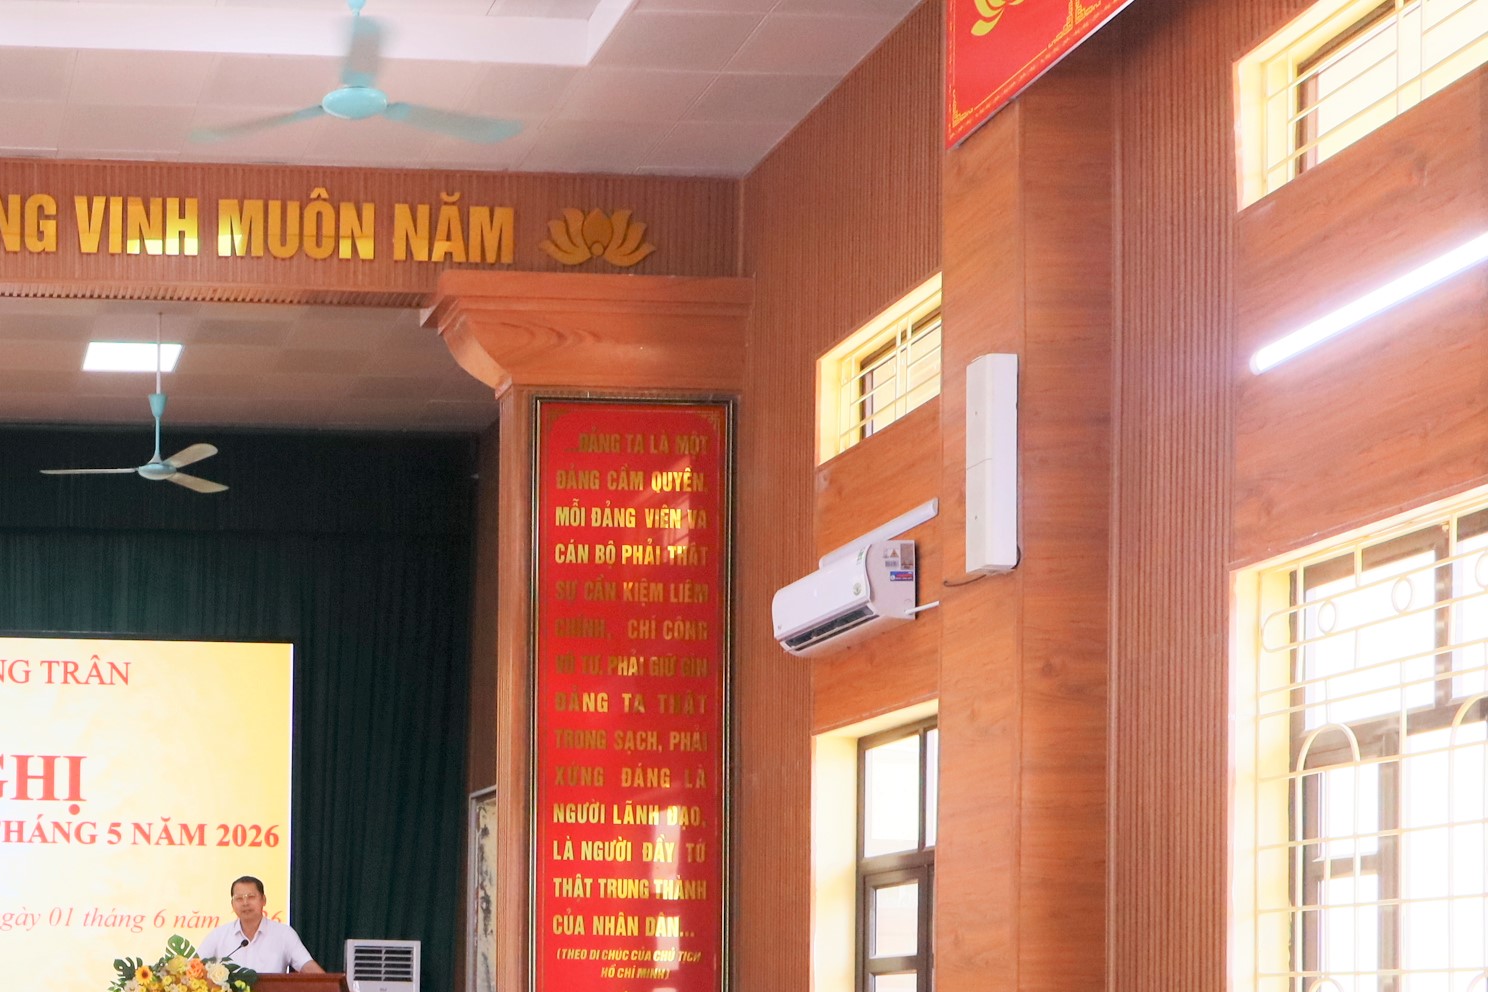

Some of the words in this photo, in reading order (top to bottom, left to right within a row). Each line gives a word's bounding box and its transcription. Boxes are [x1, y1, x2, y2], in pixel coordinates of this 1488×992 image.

[74, 194, 199, 257] VINH
[217, 187, 376, 260] MUÔN
[392, 191, 513, 264] NĂM
[556, 463, 600, 490] ĐẢNG
[607, 464, 644, 490] CẦM
[556, 499, 585, 526] MỖI
[591, 501, 636, 528] ĐẢNG
[645, 505, 682, 528] VIÊN
[555, 539, 588, 563] CÁN
[595, 540, 615, 568] BỘ
[622, 538, 660, 565] PHẢI
[623, 578, 663, 607] KIỆM
[628, 616, 655, 639] CHÍ
[663, 616, 707, 640] CÔNG
[40, 655, 131, 686] TRÂN
[622, 693, 645, 713] TA
[555, 729, 607, 750] TRONG
[670, 725, 707, 751] PHẢI
[622, 763, 671, 788] ĐÁNG
[554, 799, 605, 823] NGƯỜI
[613, 801, 659, 825] LÃNH
[107, 822, 122, 845] 5
[132, 817, 208, 847] NĂM
[216, 823, 280, 848] 2026
[553, 836, 574, 860] LÀ
[581, 836, 631, 861] NGƯỜI
[642, 834, 674, 863] ĐẦY
[553, 874, 592, 902] THẬT
[598, 878, 649, 899] TRUNG
[654, 875, 707, 900] THÀNH
[49, 905, 73, 927] 01
[83, 905, 145, 932] tháng
[153, 909, 166, 928] 6
[173, 910, 220, 929] năm
[553, 909, 584, 935] CỦA
[593, 913, 639, 936] NHÂN
[557, 948, 587, 960] (THEO
[589, 949, 600, 960] DI
[631, 947, 651, 961] CỦA
[617, 965, 635, 978] CHÍ
